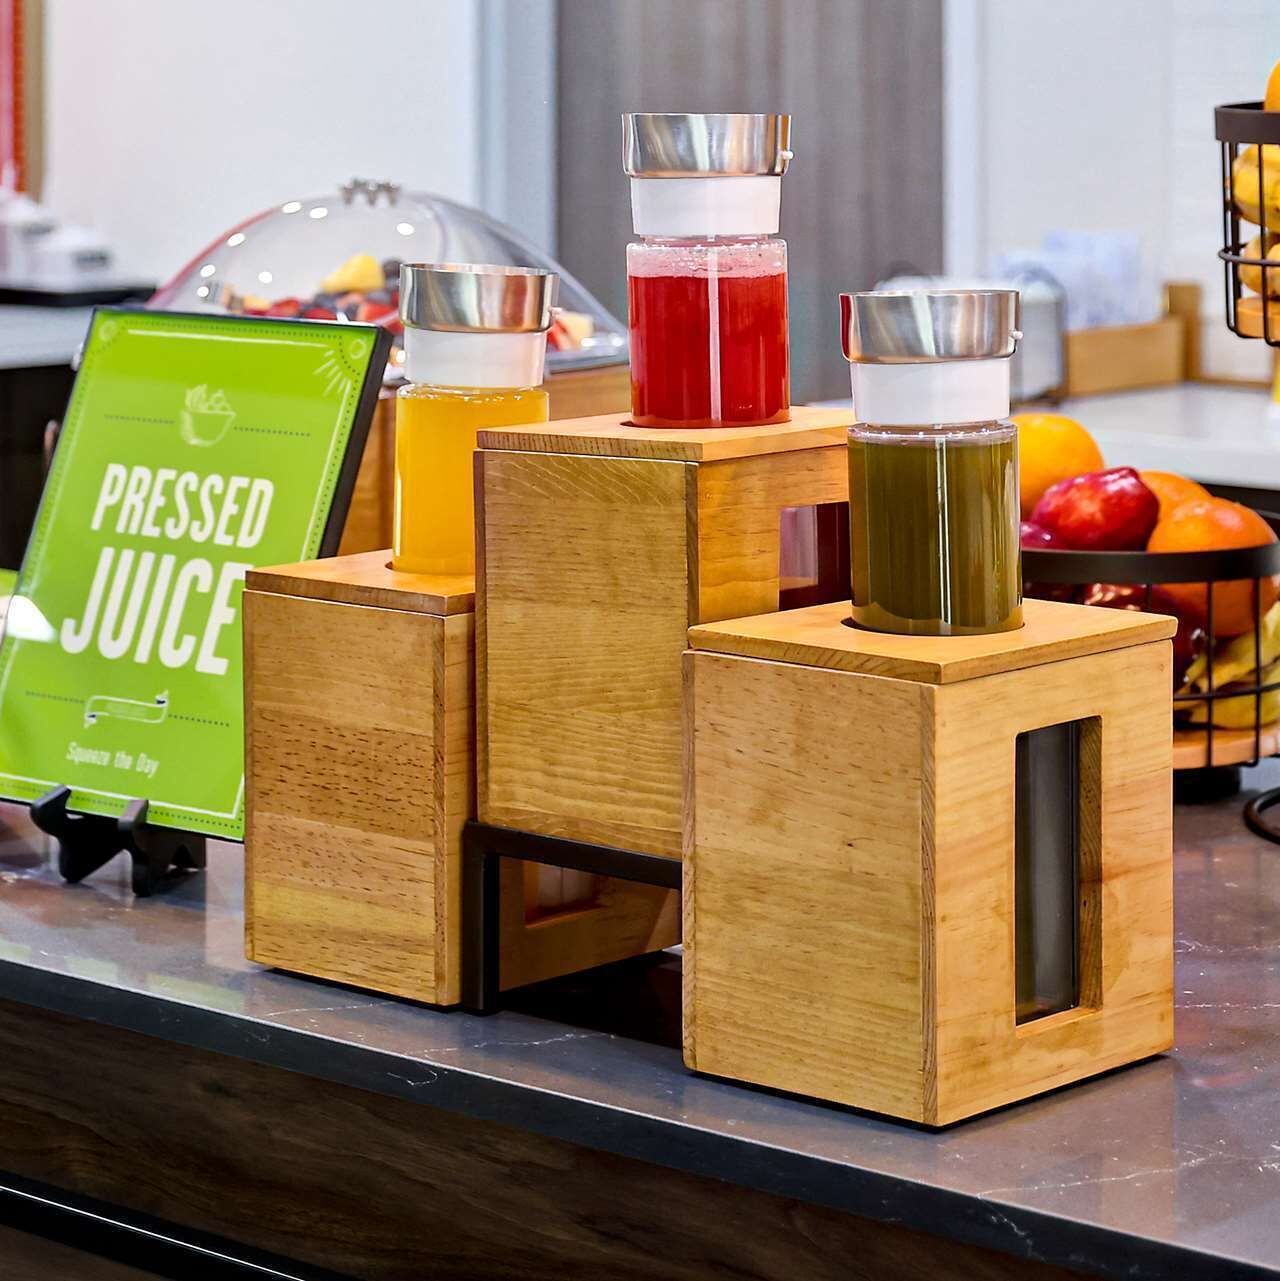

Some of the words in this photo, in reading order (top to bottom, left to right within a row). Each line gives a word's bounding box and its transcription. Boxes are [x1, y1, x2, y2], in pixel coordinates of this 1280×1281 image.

[91, 463, 275, 549] PRESSED
[60, 545, 254, 676] JUICE
[65, 740, 112, 767] Squeeze
[113, 750, 134, 770] the
[135, 752, 160, 779] Day
